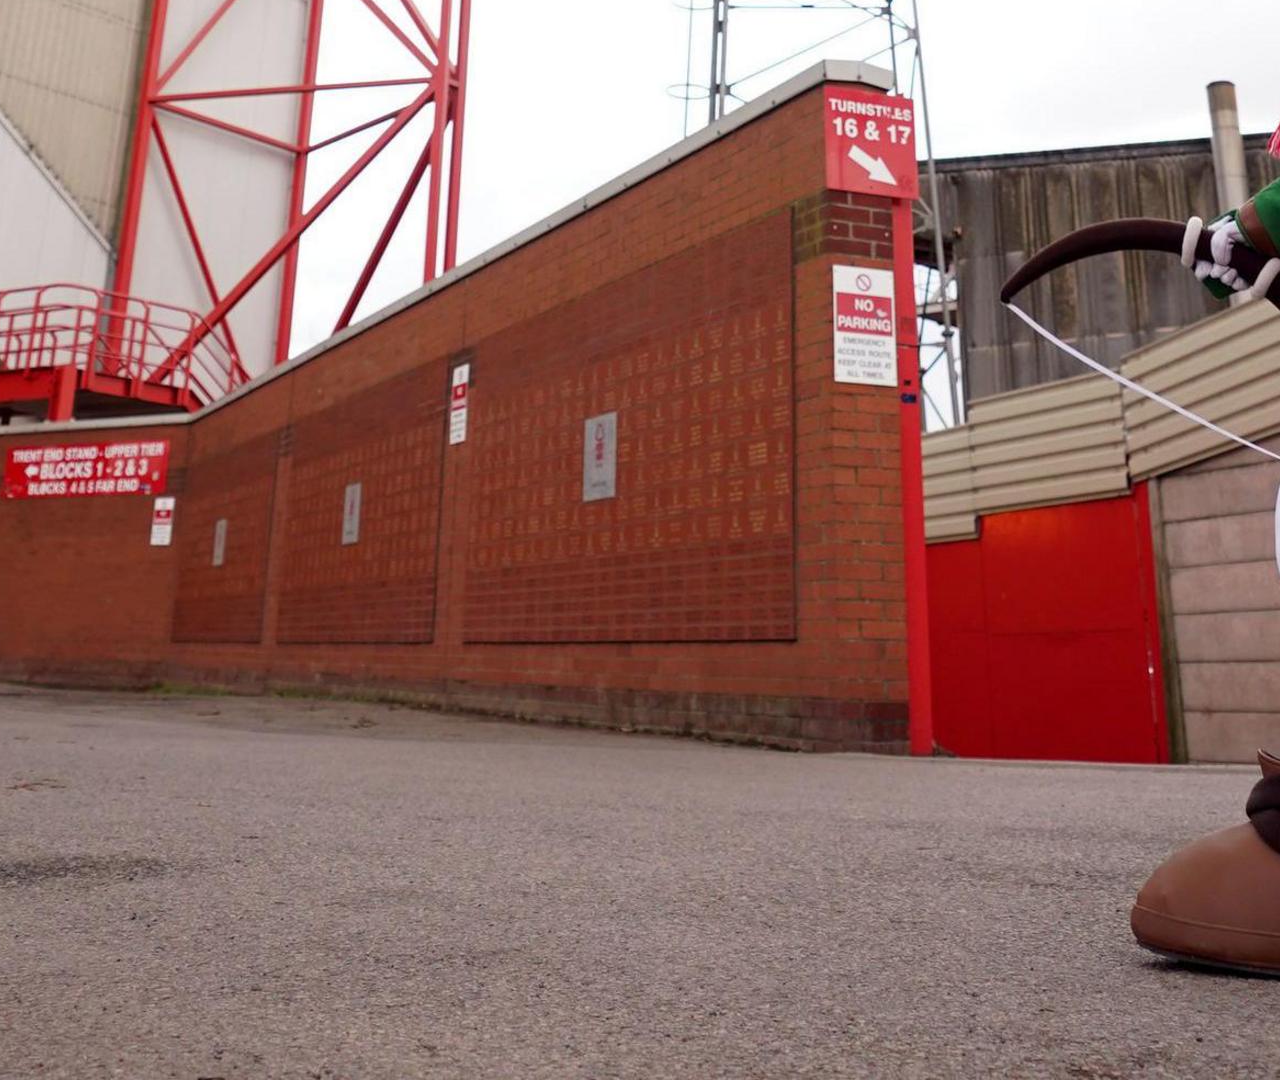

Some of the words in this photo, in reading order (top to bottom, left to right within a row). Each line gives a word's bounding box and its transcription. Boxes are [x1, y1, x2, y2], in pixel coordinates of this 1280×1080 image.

[832, 116, 859, 139] 16
[864, 120, 880, 141] &
[887, 124, 912, 145] 17
[853, 298, 874, 312] NO
[838, 314, 891, 333] PARKING
[13, 449, 43, 464] TRENT
[43, 447, 64, 462] END
[65, 445, 98, 461] STAND
[104, 443, 139, 459] UPPER
[140, 441, 165, 457] TIER
[40, 460, 94, 480] BLOCKS
[96, 461, 104, 478] 1
[113, 458, 124, 477] 2
[125, 457, 136, 477] &
[138, 456, 149, 476] 3
[27, 480, 67, 496] BLOCKS
[95, 478, 116, 493] FAR
[117, 477, 140, 493] END
